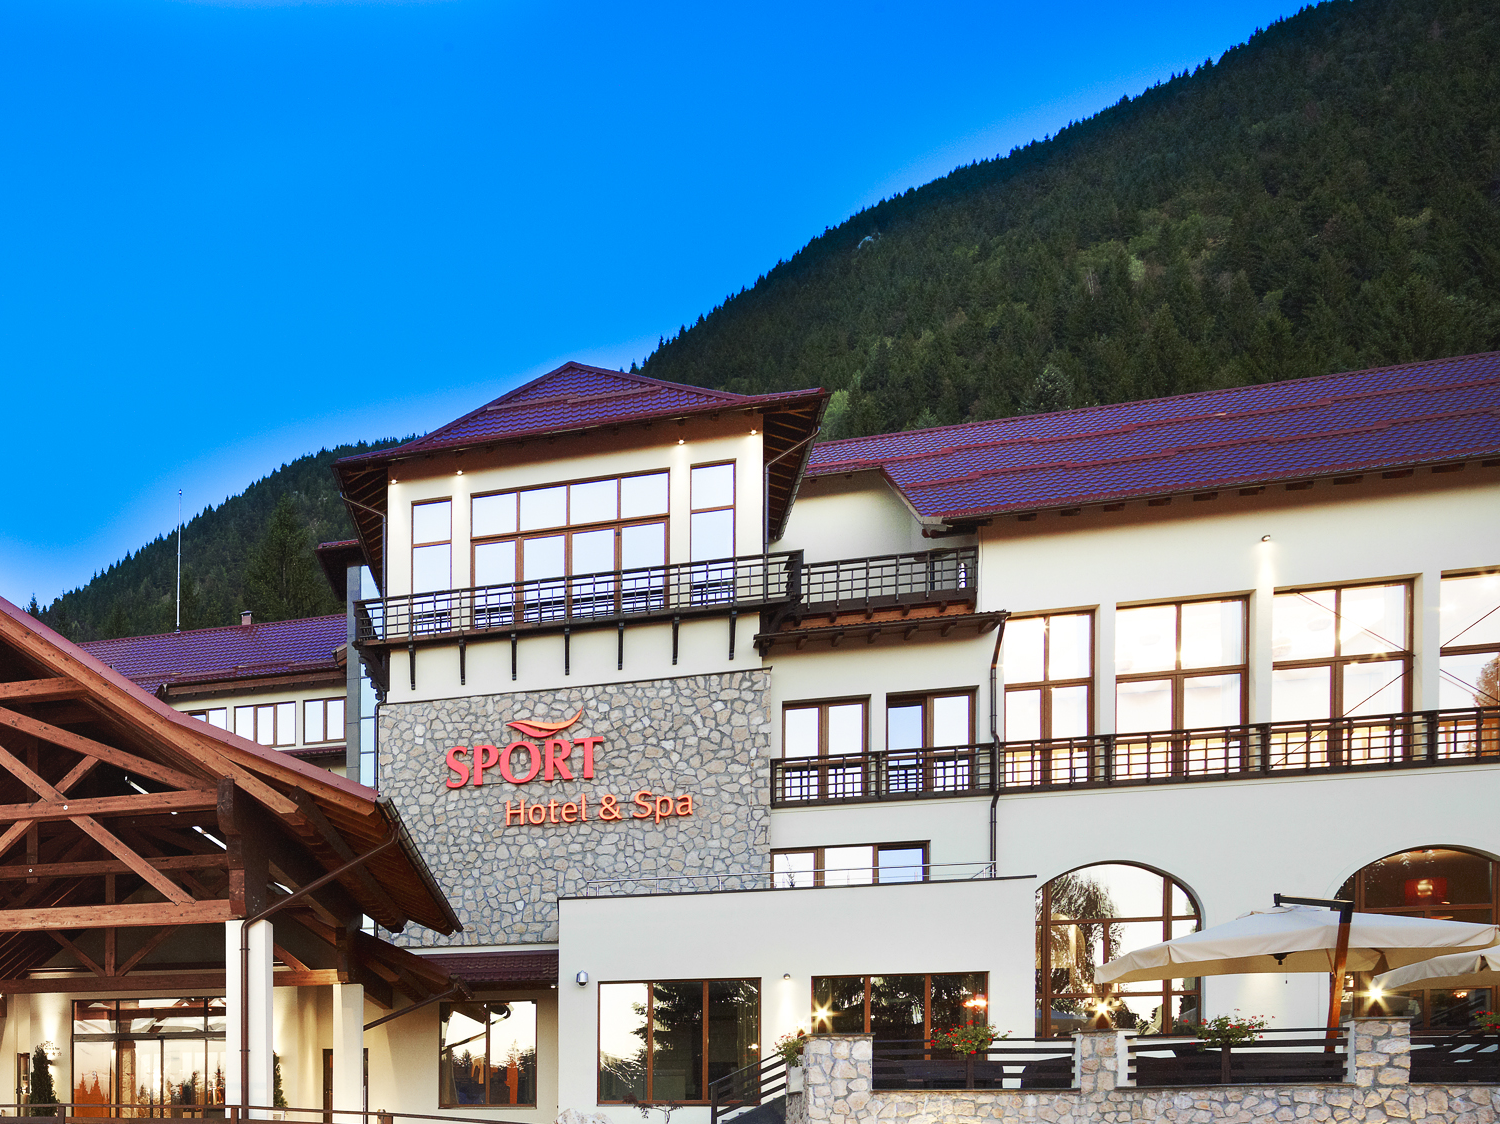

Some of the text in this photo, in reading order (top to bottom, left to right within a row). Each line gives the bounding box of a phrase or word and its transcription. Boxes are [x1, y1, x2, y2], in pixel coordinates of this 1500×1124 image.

[446, 736, 603, 788] SPORT
[506, 791, 693, 826] Hotel & Spa
